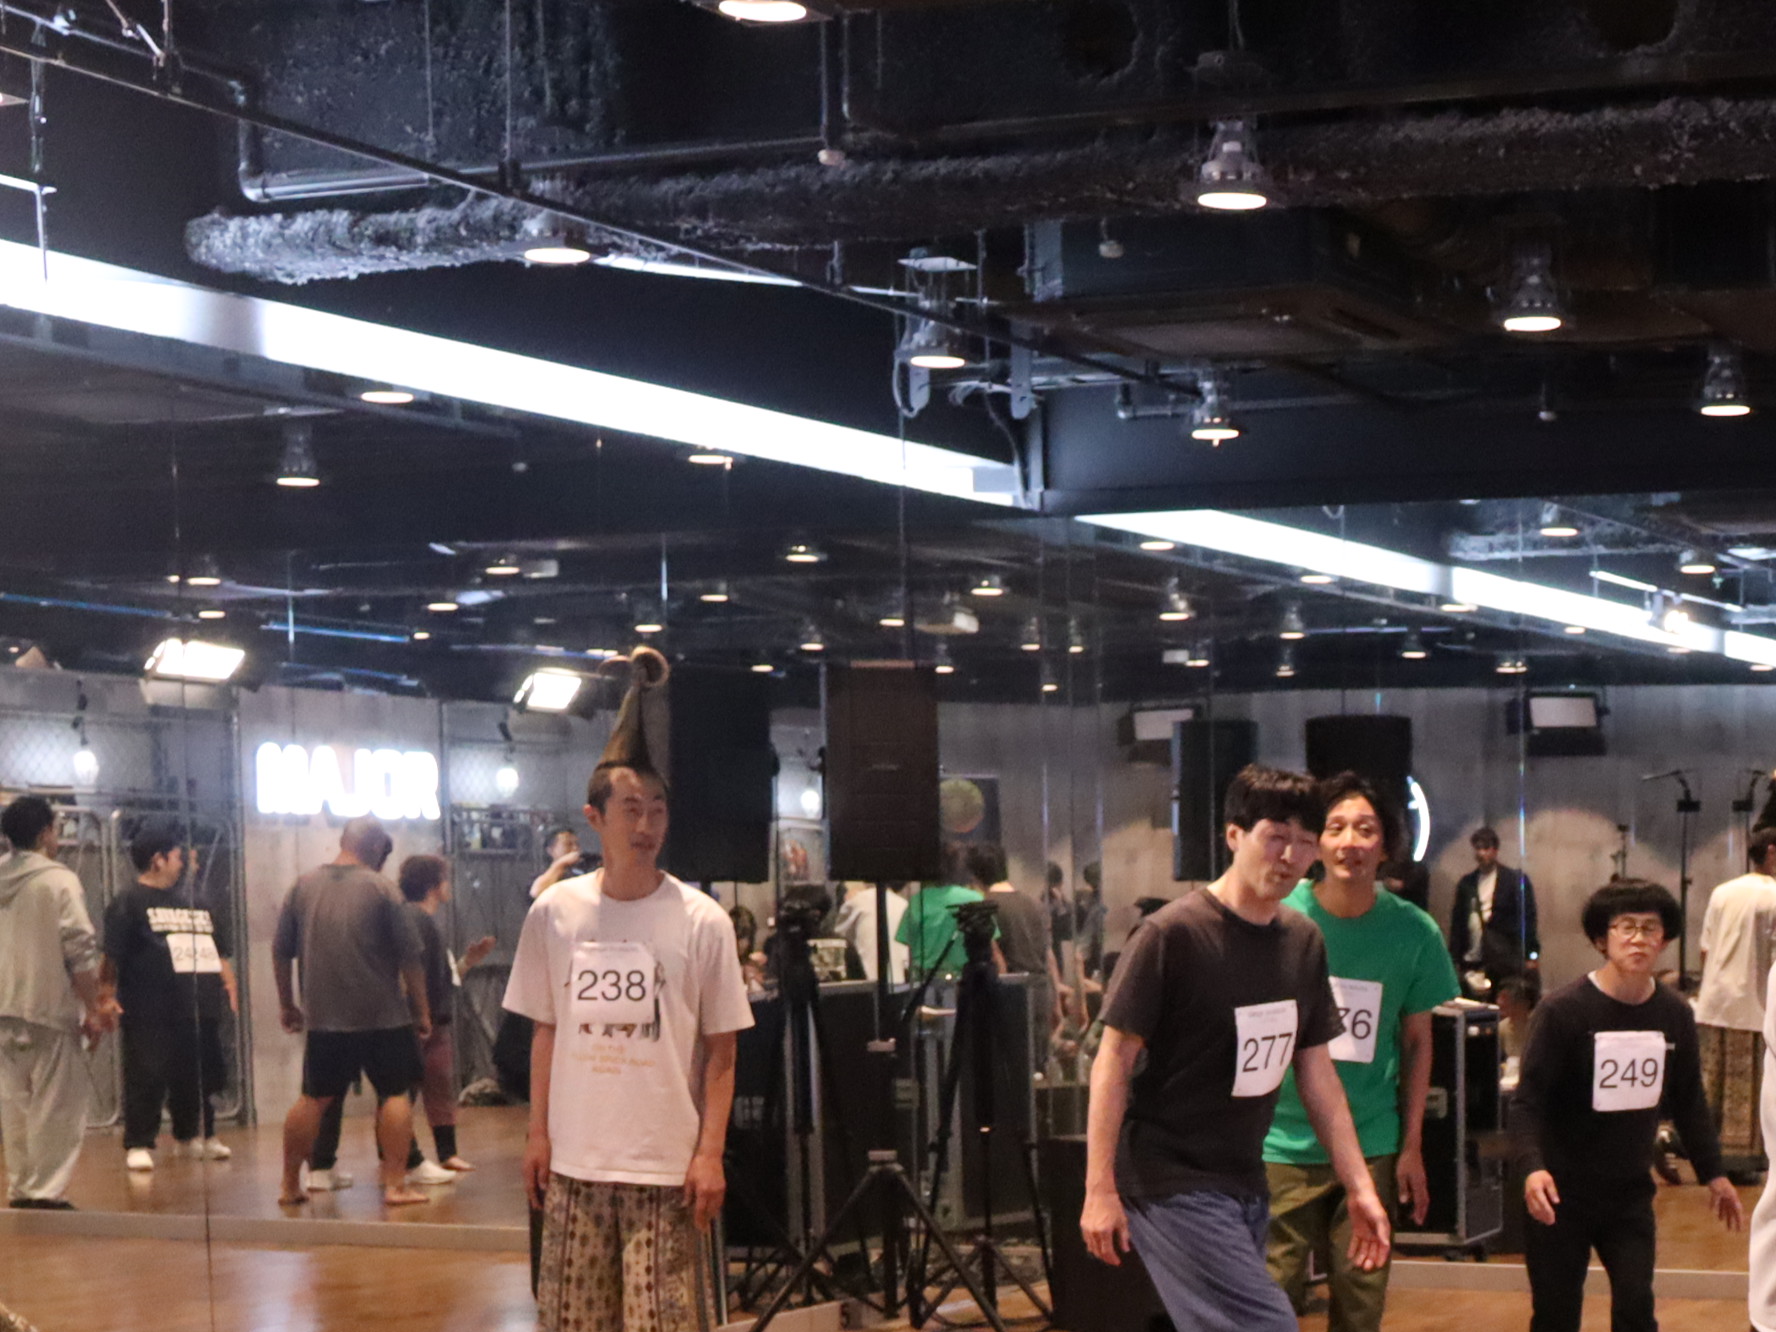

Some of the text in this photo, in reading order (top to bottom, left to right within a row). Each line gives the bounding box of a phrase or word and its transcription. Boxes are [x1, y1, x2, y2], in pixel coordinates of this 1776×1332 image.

[256, 741, 441, 820] MAJOR
[577, 969, 647, 1002] 238
[1242, 1031, 1293, 1073] 277
[1598, 1057, 1659, 1089] 249
